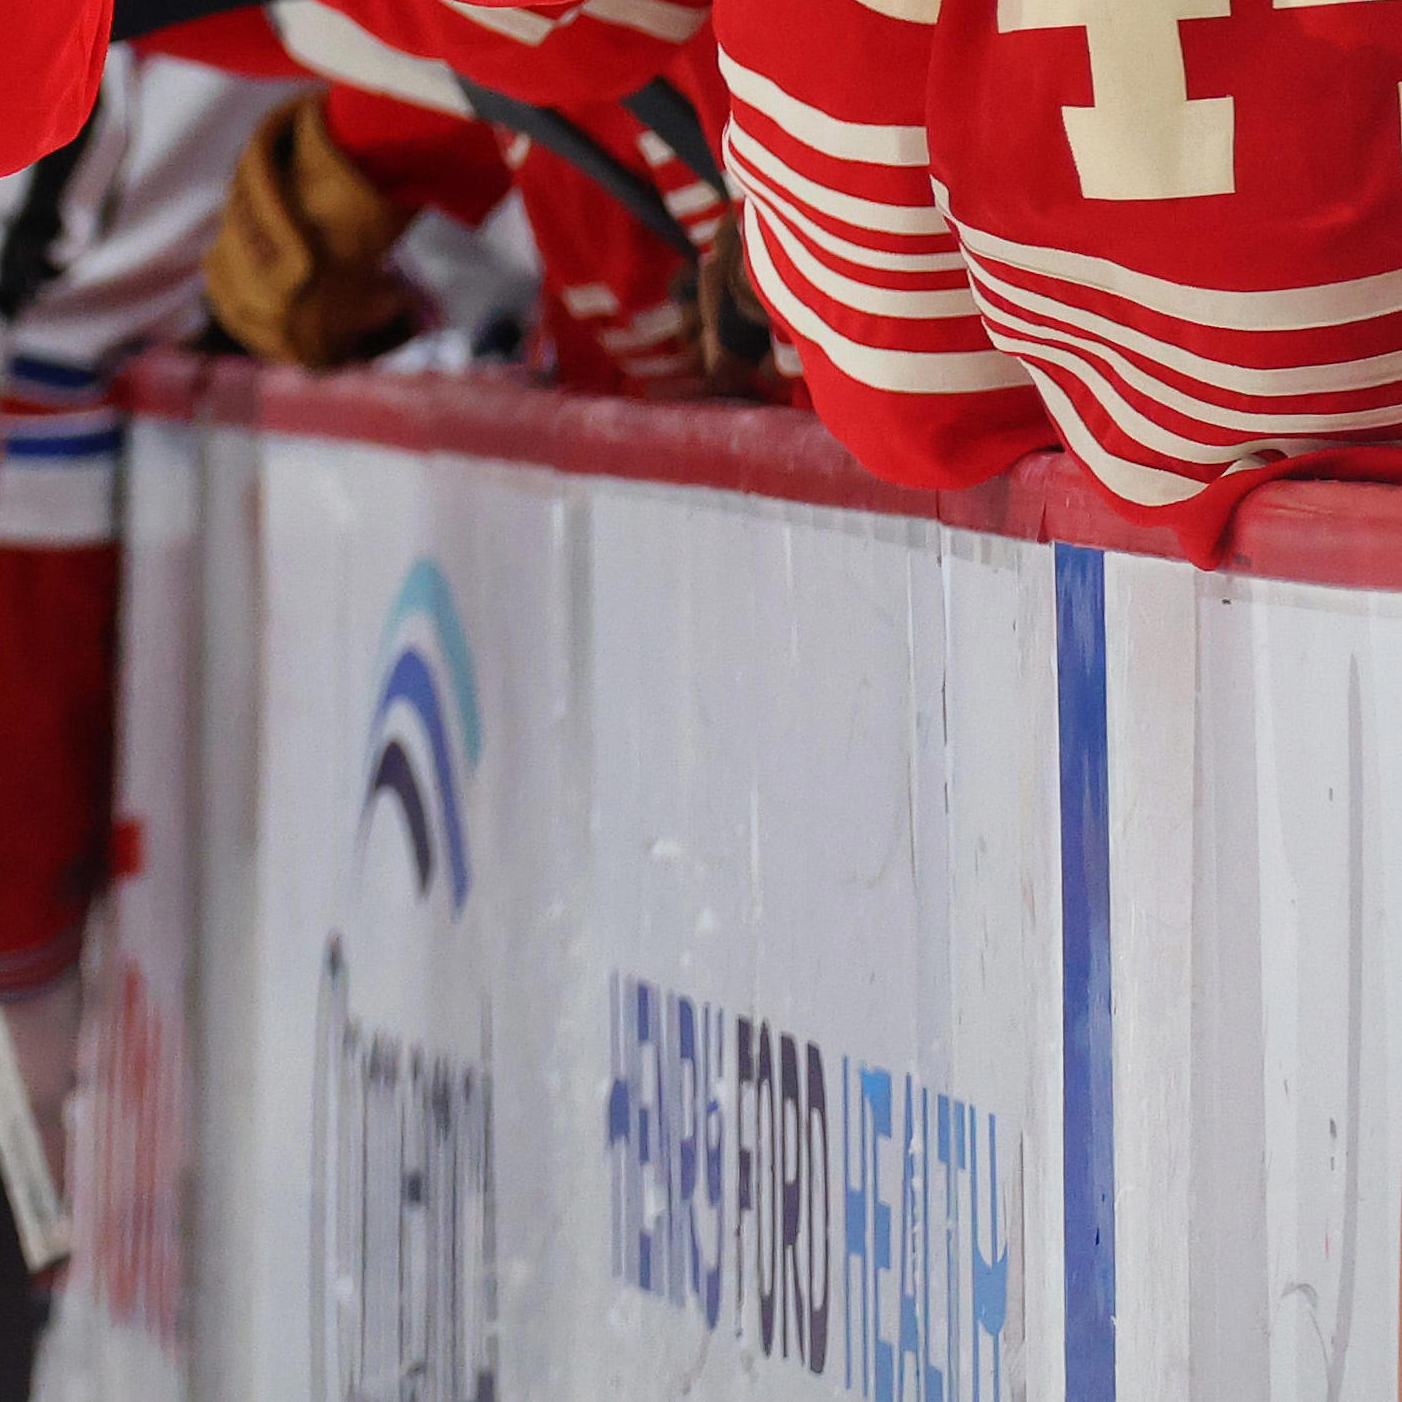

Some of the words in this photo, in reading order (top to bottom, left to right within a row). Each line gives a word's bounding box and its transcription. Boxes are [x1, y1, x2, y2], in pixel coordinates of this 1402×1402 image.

[609, 972, 724, 1332] HENRY
[736, 1013, 830, 1376] FORD
[843, 1054, 1009, 1402] HEALTH
